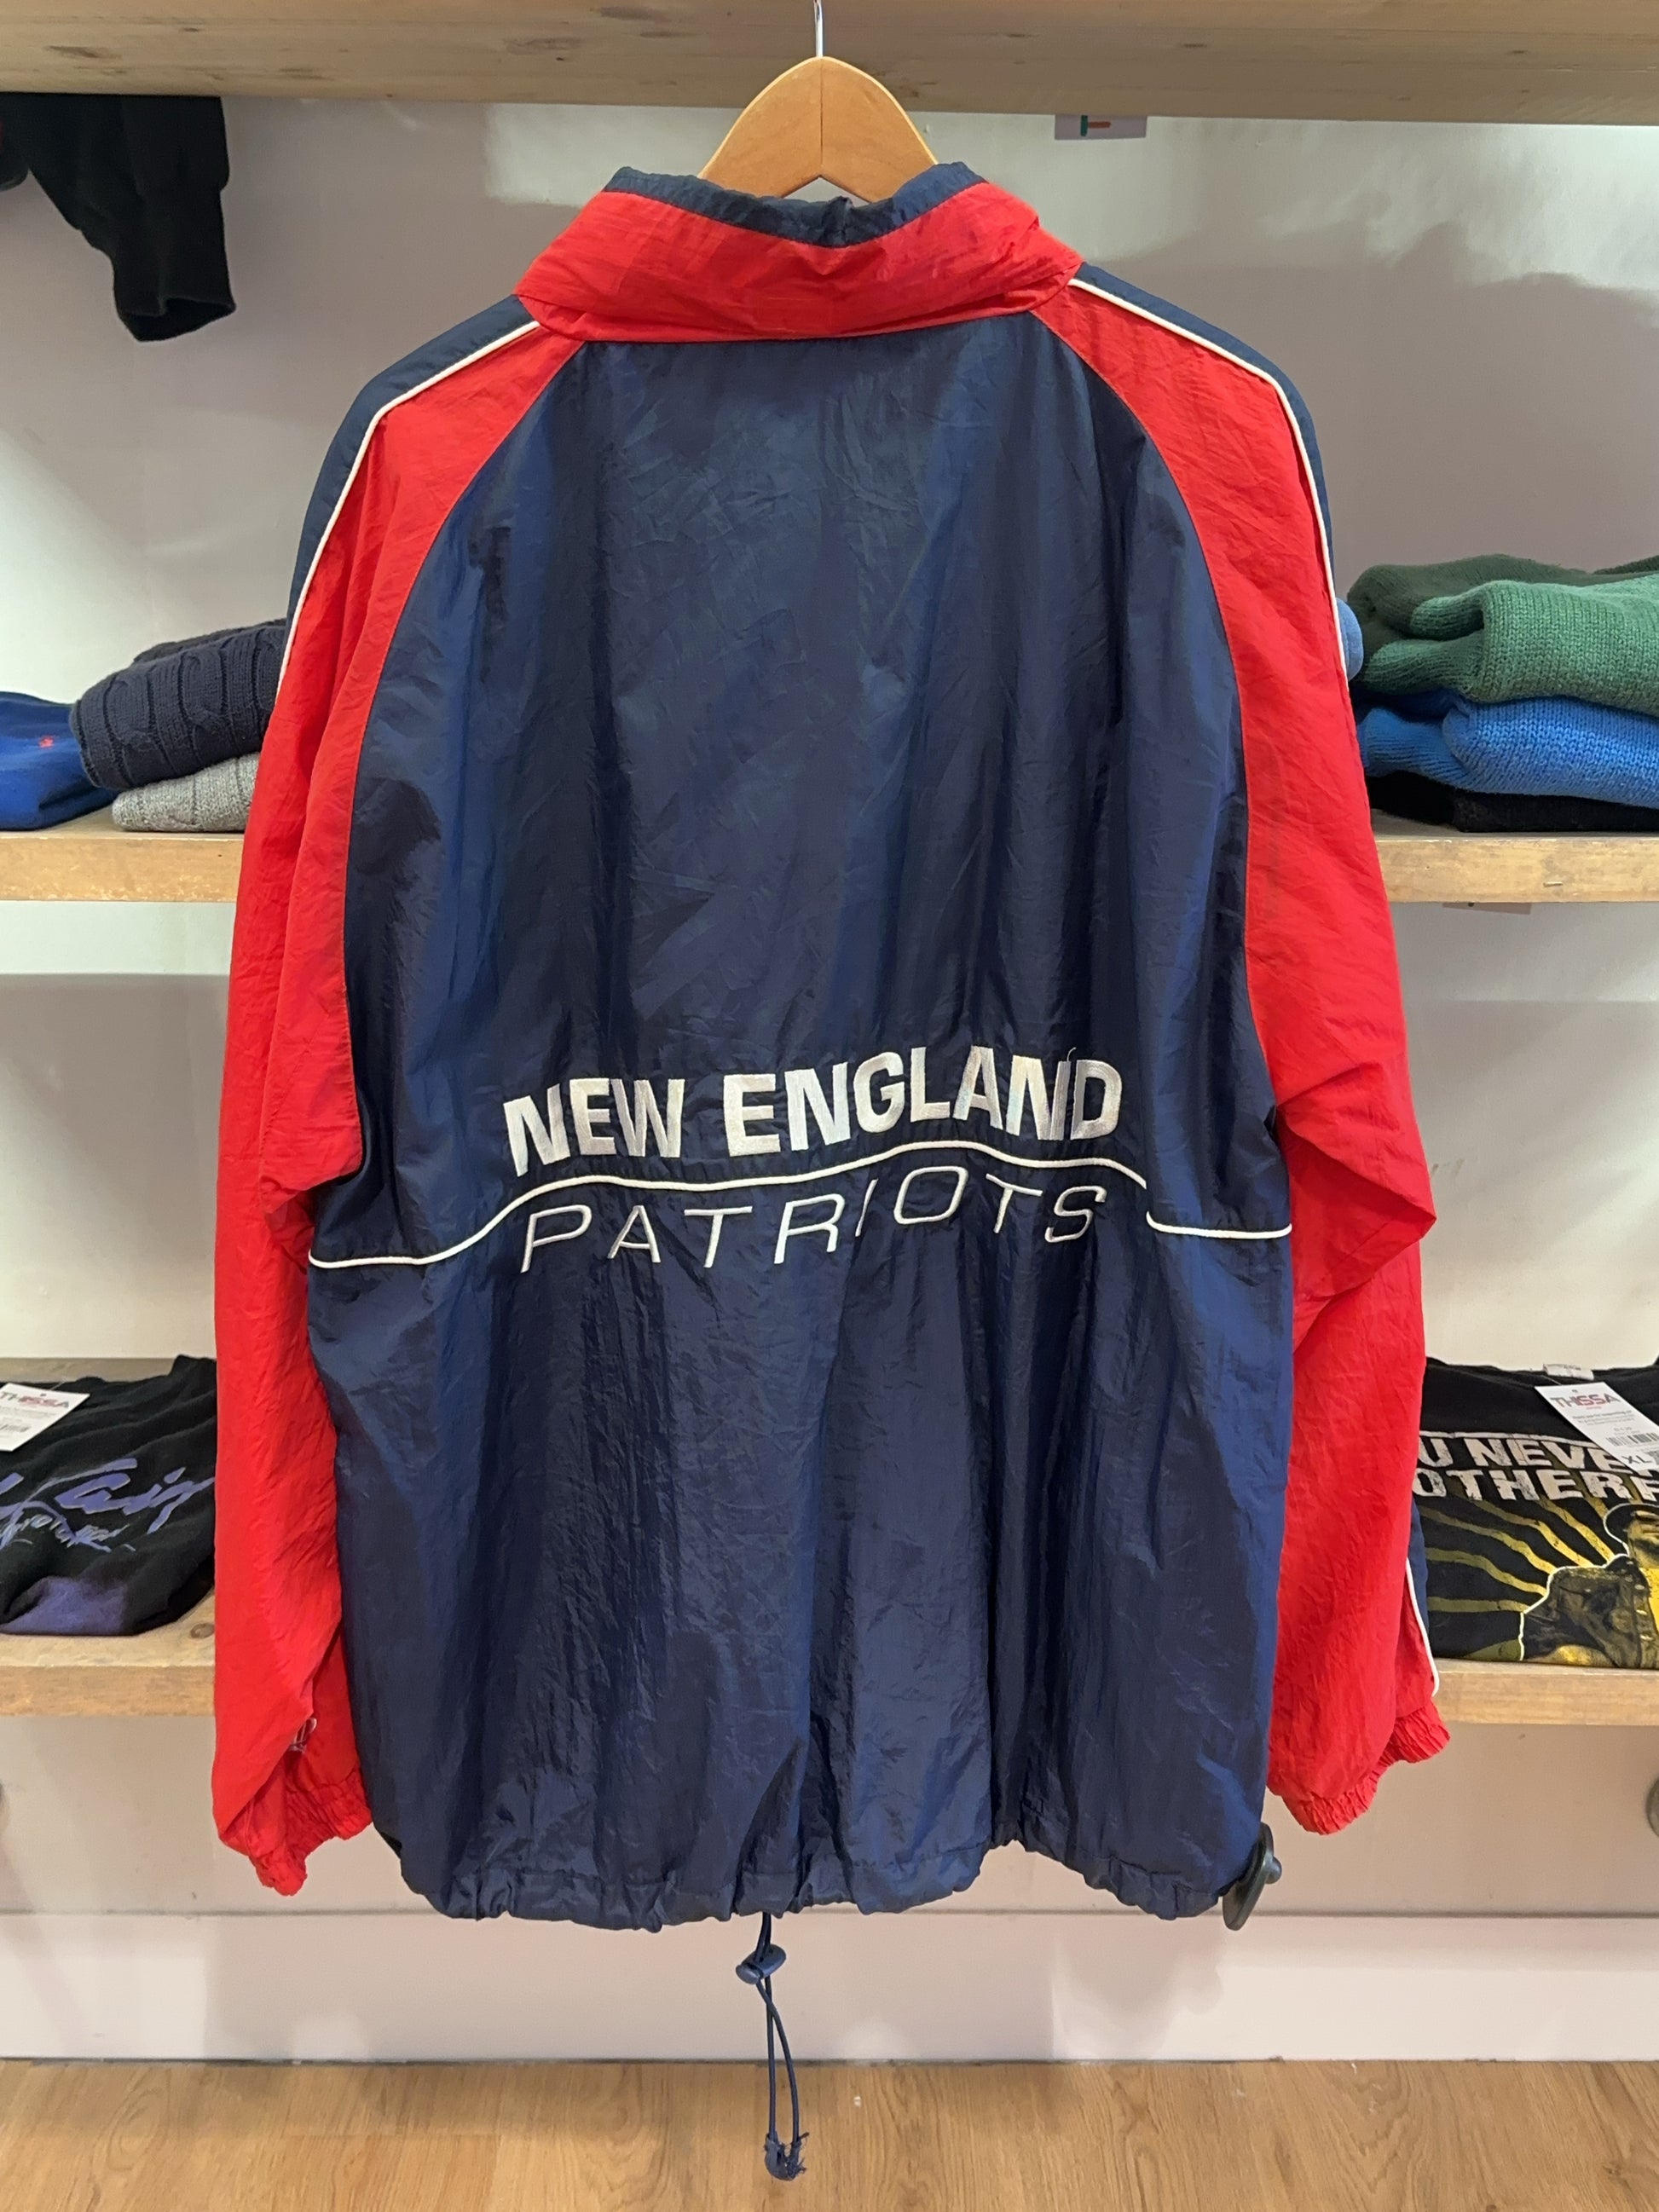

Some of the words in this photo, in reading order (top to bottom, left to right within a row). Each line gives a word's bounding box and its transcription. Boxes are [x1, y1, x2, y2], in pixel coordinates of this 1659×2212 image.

[503, 1077, 685, 1177] NEW
[723, 1046, 1122, 1158] ENGLAND
[520, 1165, 1107, 1273] PATRIOTS
[1621, 1454, 1652, 1464] XL
